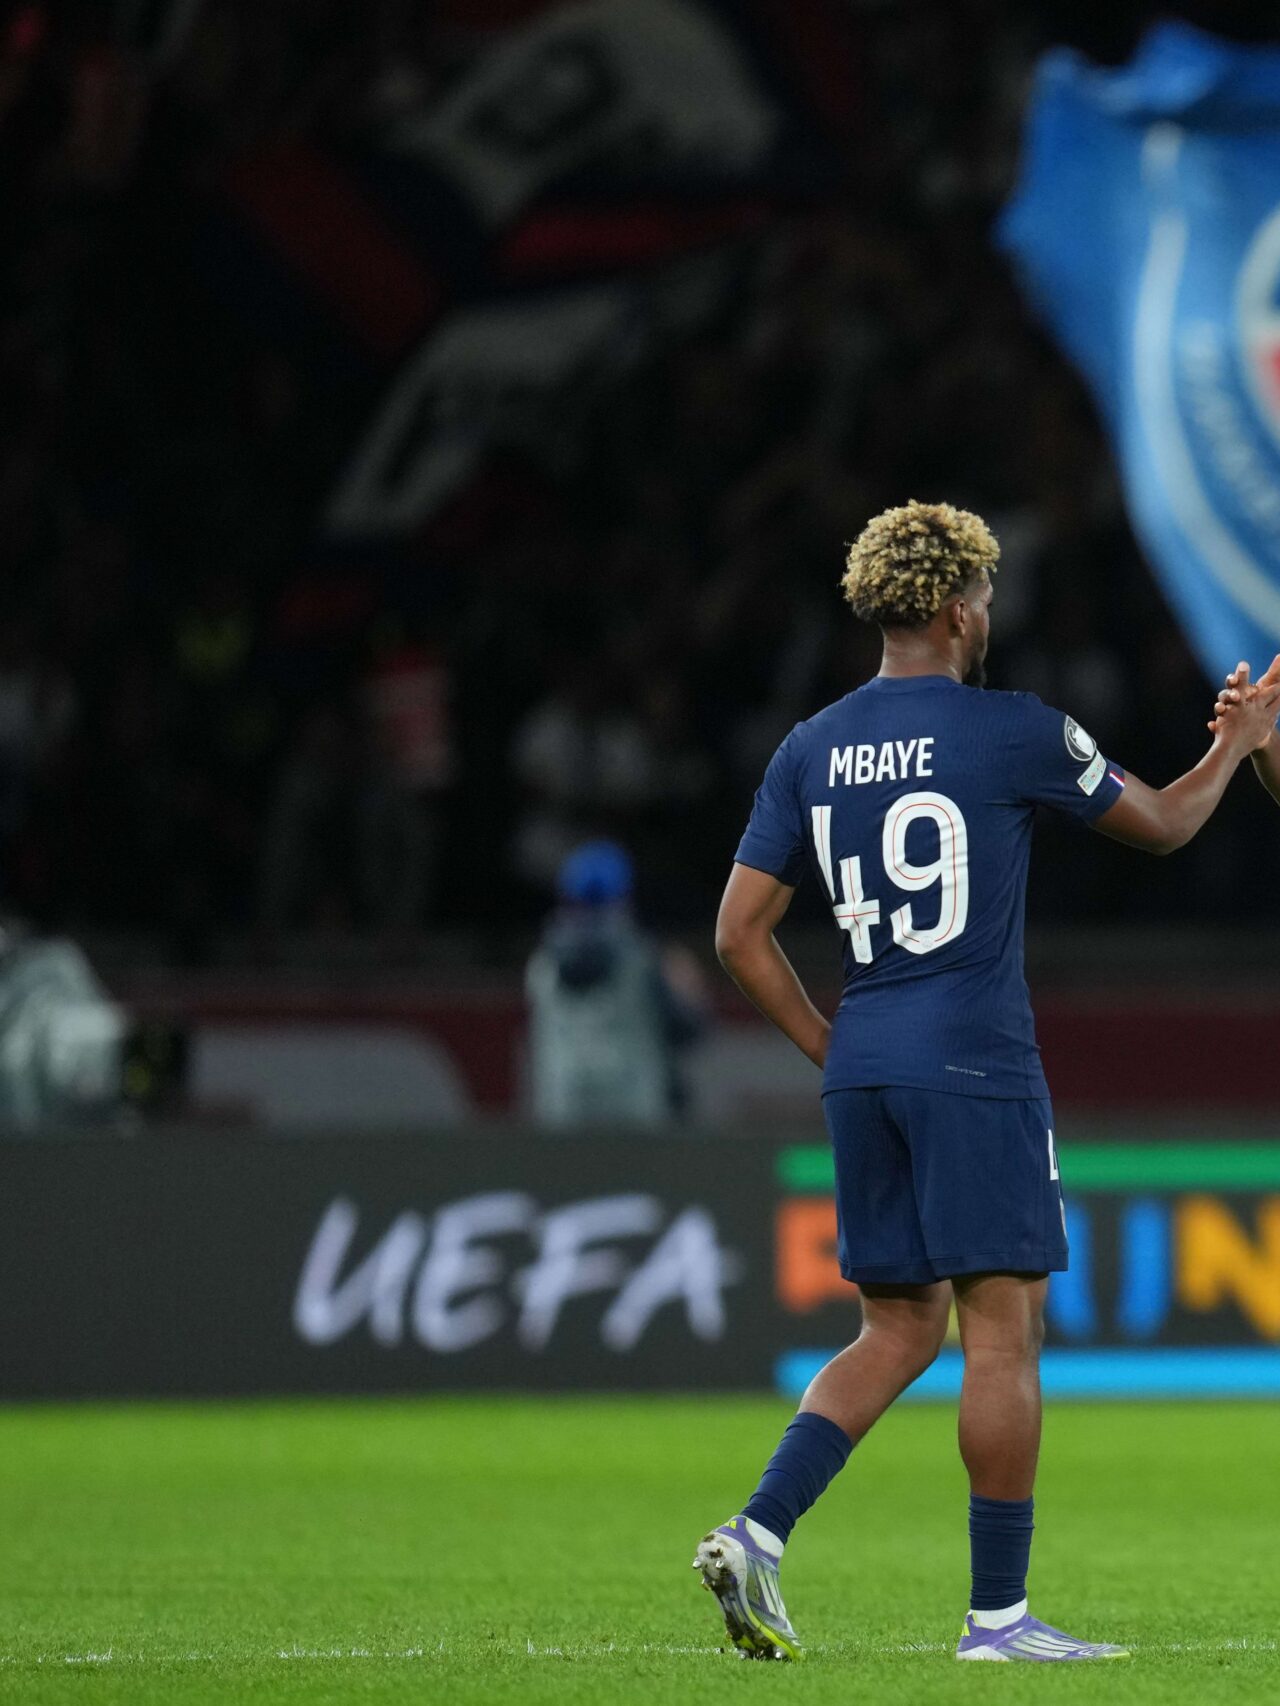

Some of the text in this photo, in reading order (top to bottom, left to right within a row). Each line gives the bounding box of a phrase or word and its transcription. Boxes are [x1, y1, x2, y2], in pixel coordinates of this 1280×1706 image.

[828, 737, 935, 788] MBAYE
[811, 791, 969, 964] 49
[295, 1192, 742, 1352] UEFA
